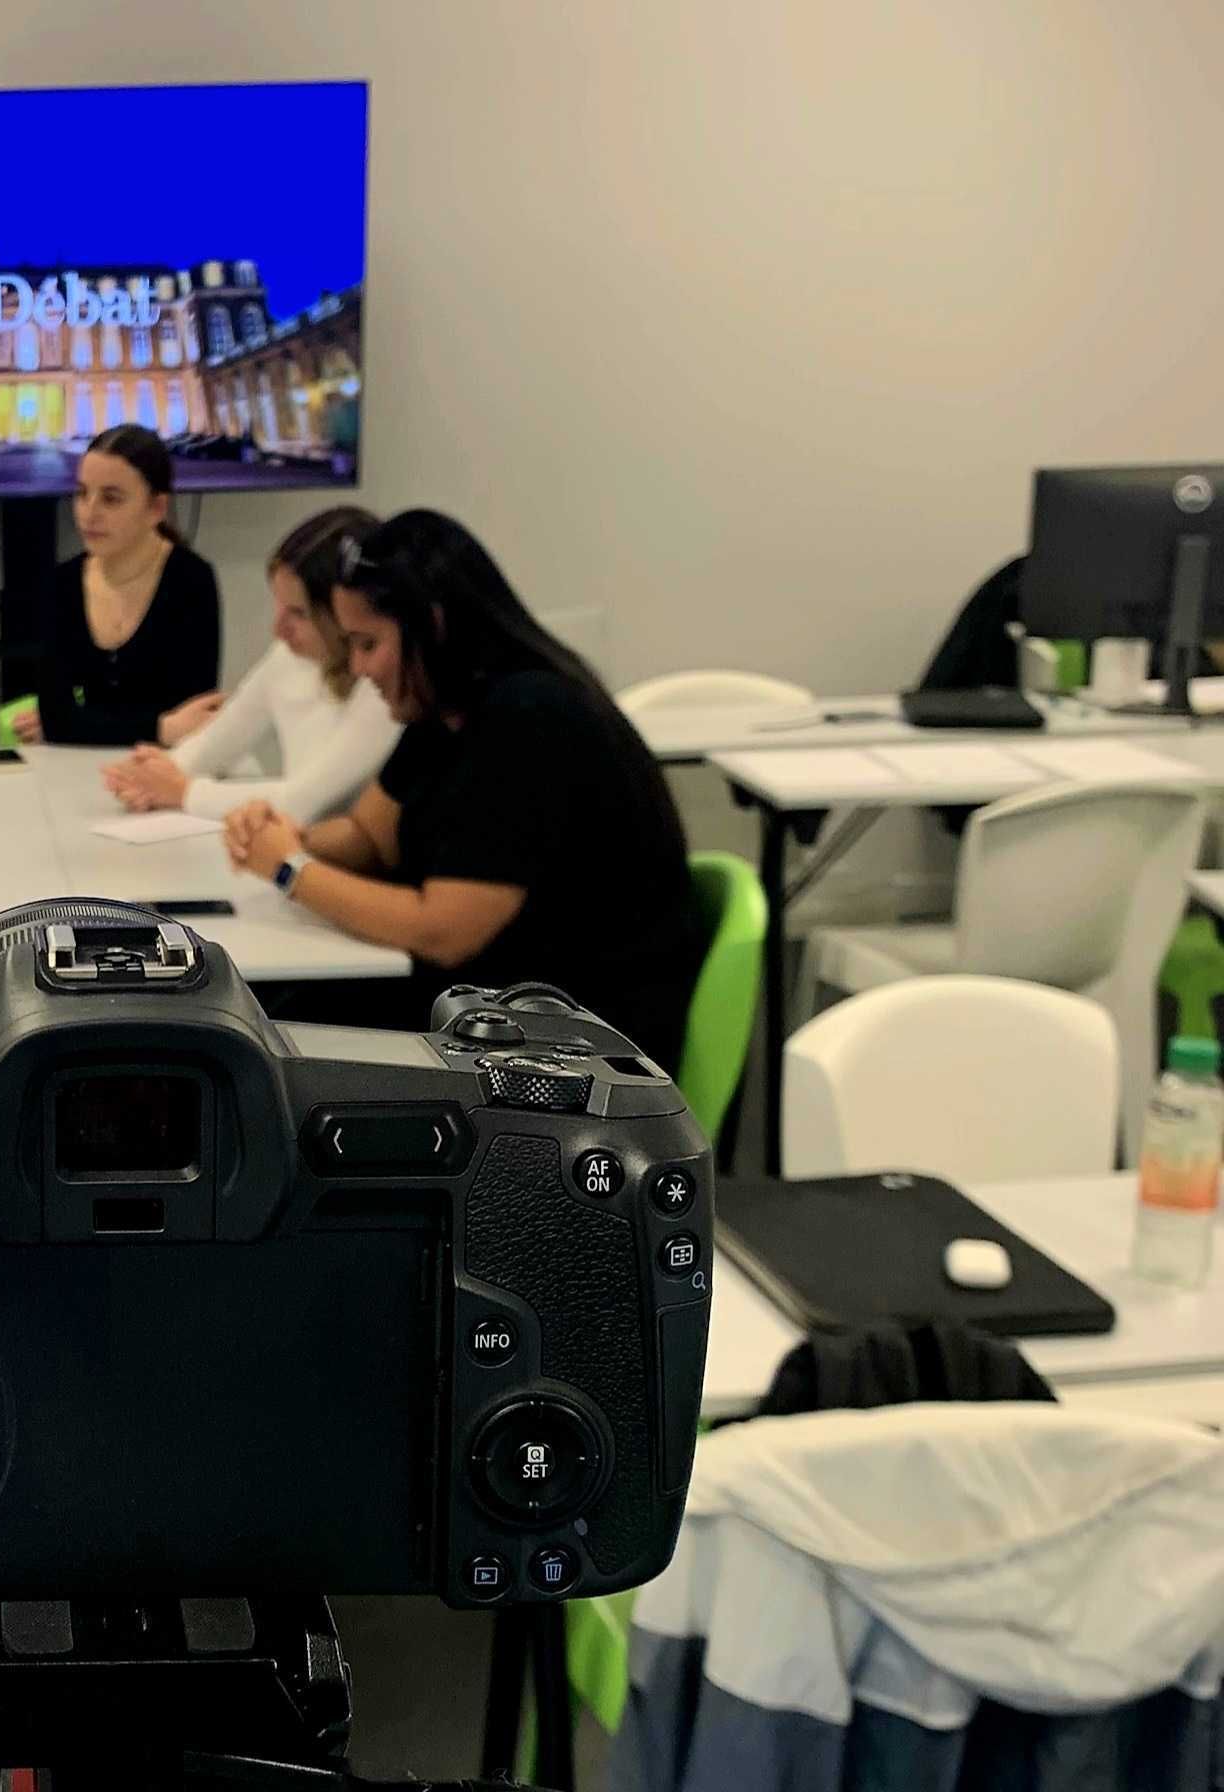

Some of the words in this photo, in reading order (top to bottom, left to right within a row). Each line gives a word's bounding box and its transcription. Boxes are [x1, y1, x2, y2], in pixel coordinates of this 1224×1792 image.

[587, 1160, 609, 1176] AF
[586, 1176, 610, 1192] ON
[474, 1333, 510, 1349] INFO
[522, 1464, 549, 1479] SET
